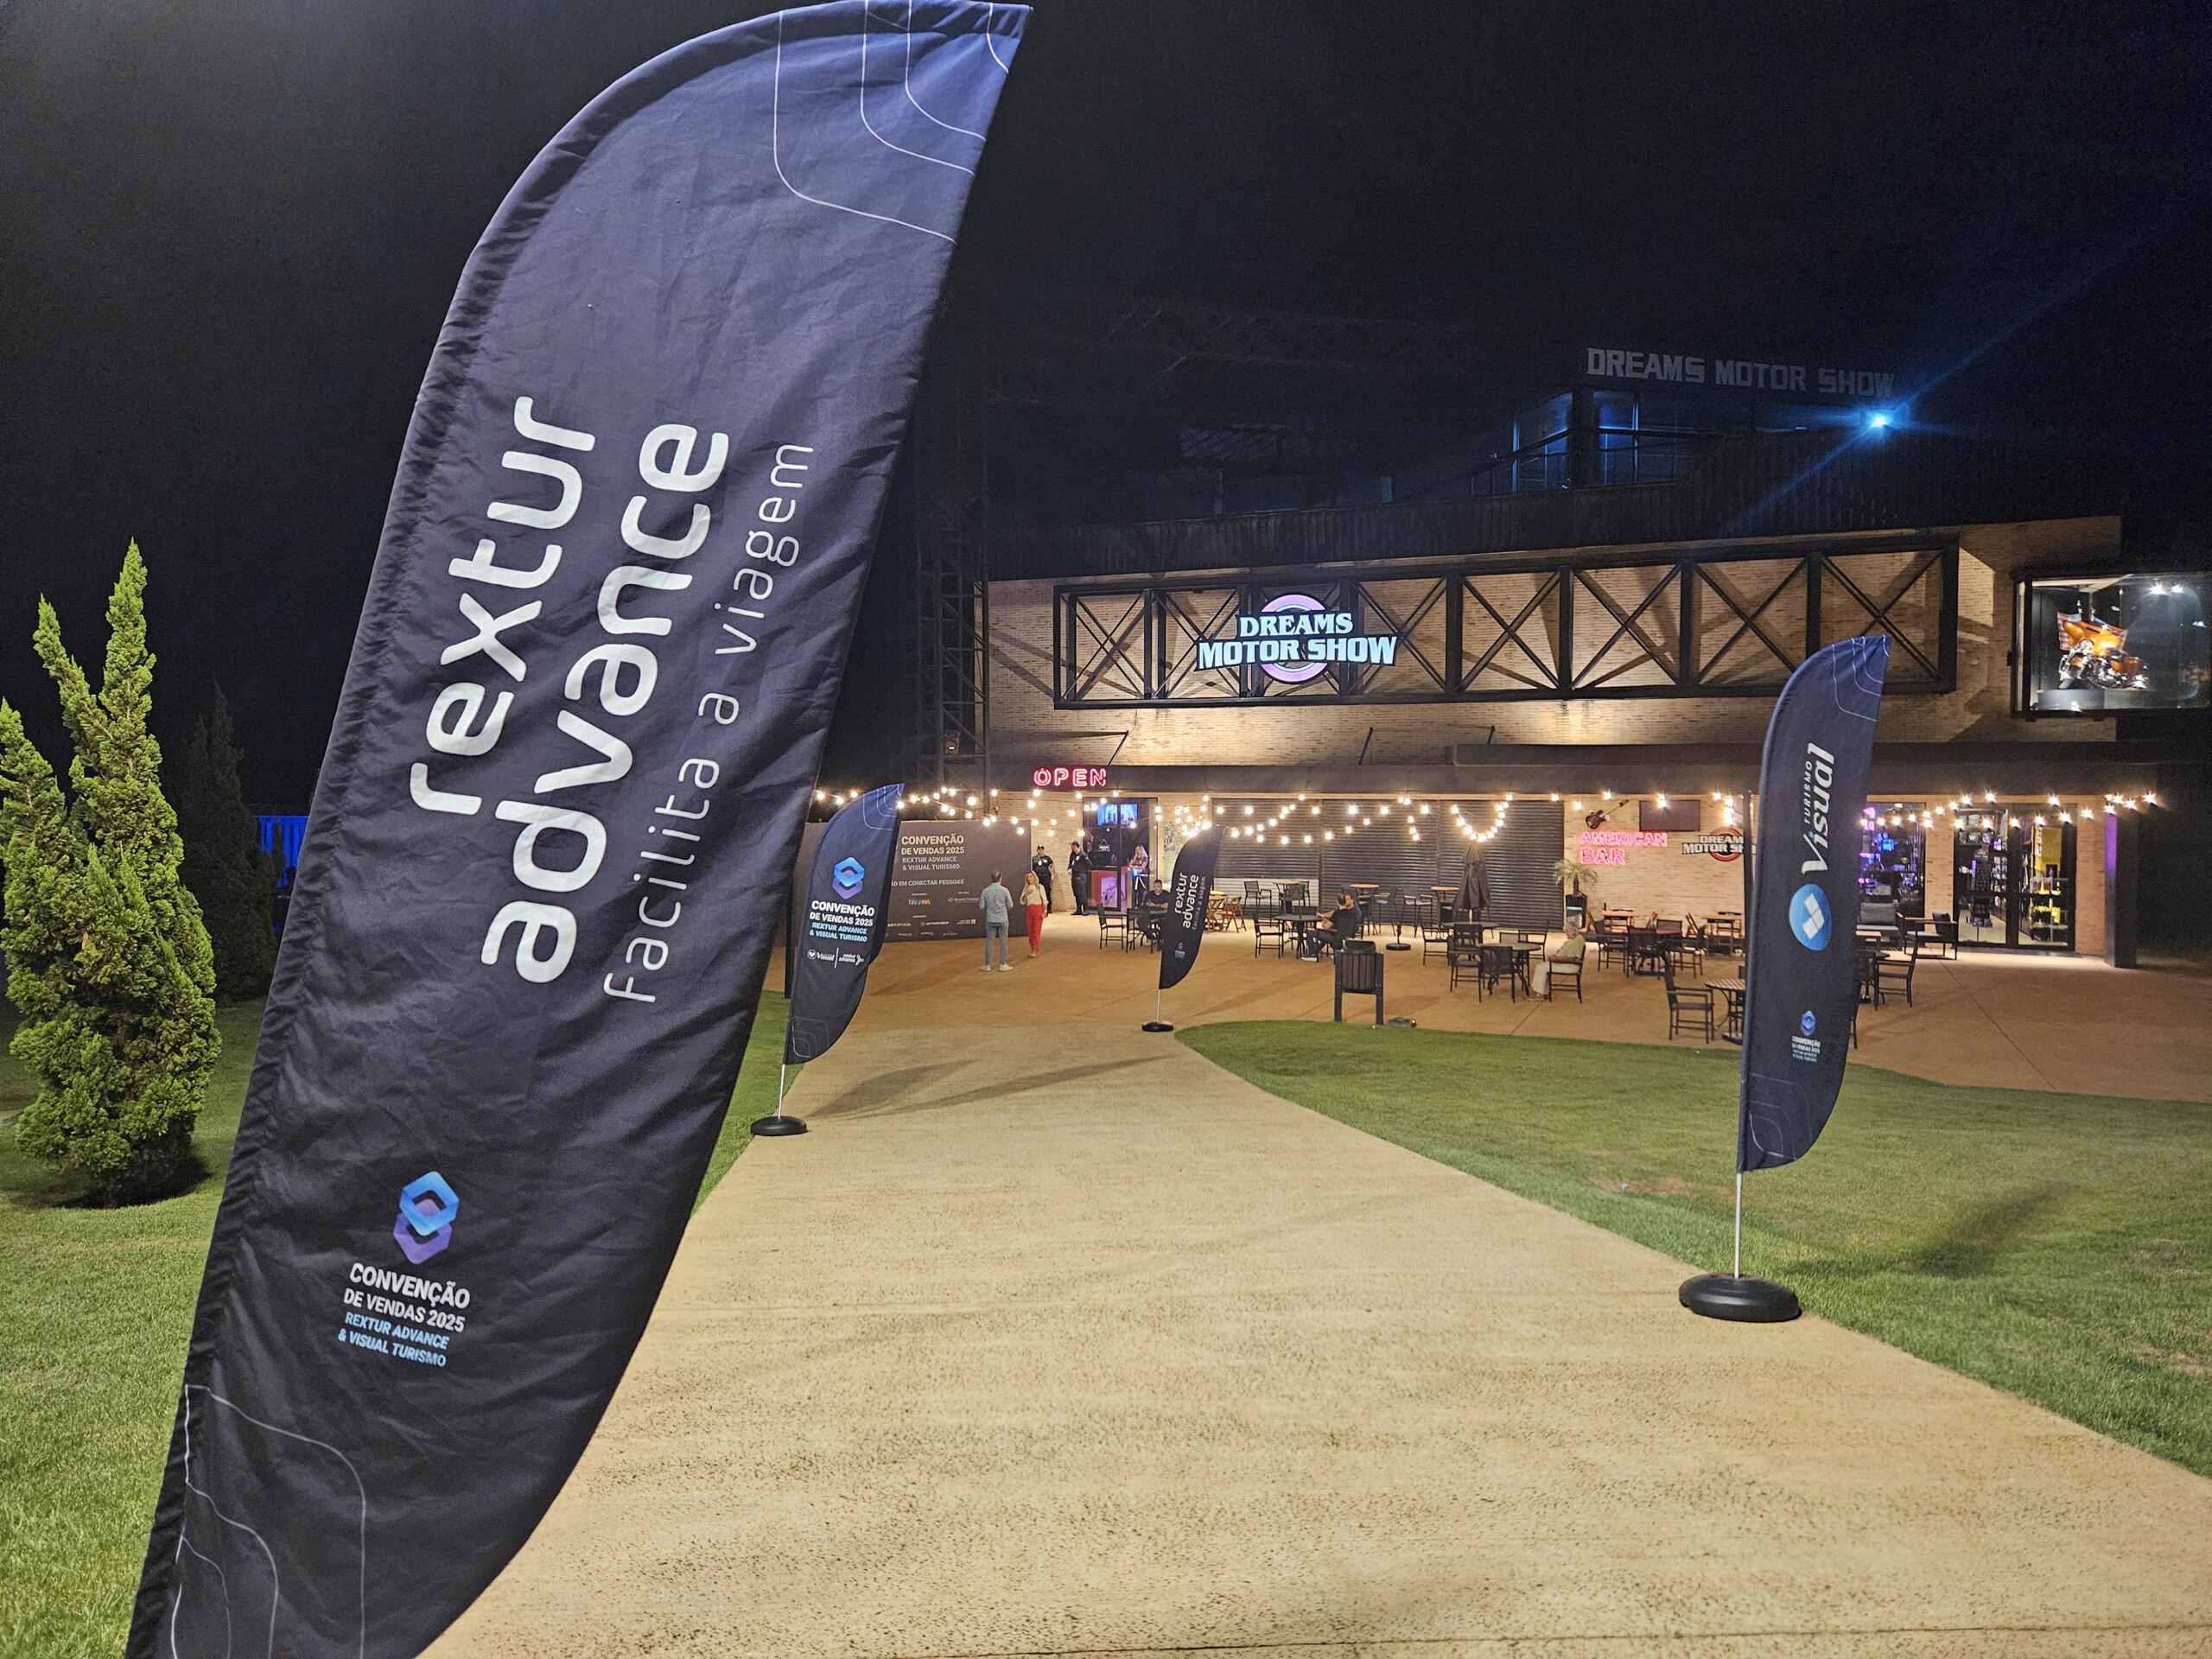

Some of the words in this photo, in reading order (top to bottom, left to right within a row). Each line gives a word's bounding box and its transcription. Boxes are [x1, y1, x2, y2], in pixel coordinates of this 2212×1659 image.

[1586, 347, 1705, 383] DREAMS
[1714, 359, 1807, 391] MOTOR
[1818, 367, 1897, 397] SHOW
[713, 443, 814, 655] viagem
[410, 396, 596, 815] rextur
[1240, 613, 1353, 637] DREAMS
[1198, 639, 1300, 669] MOTOR
[1308, 636, 1397, 664] SHOW
[480, 423, 729, 983] advance
[697, 692, 740, 725] a
[1033, 768, 1107, 786] OPEN
[1803, 760, 1812, 824] TURISMO
[1802, 742, 1834, 874] Visual
[901, 833, 964, 846] CONVENÇÃO
[1580, 831, 1668, 847] AMERICAN
[1683, 843, 1727, 854] MOTOR
[1700, 836, 1744, 844] DREAM
[1580, 847, 1625, 865] BAR
[811, 900, 874, 917] CONVENÇÃO
[1174, 873, 1187, 913] rextur
[1183, 874, 1198, 929] advance
[810, 912, 821, 920] DE
[822, 913, 854, 925] VENDAS
[855, 918, 873, 926] 2025
[812, 922, 837, 931] REXTUR
[816, 931, 838, 939] VISUAL
[839, 933, 868, 942] TURISMO
[349, 1262, 470, 1309] CONVENÇÃO
[344, 1288, 364, 1307] DE
[366, 1294, 426, 1323] VENDAS
[426, 1310, 465, 1332] 2025
[338, 1328, 346, 1342] &
[349, 1331, 389, 1354] VISUAL
[392, 1343, 446, 1367] TURISMO
[345, 1312, 391, 1335] REXTUR
[391, 1325, 450, 1350] ADVANCE
